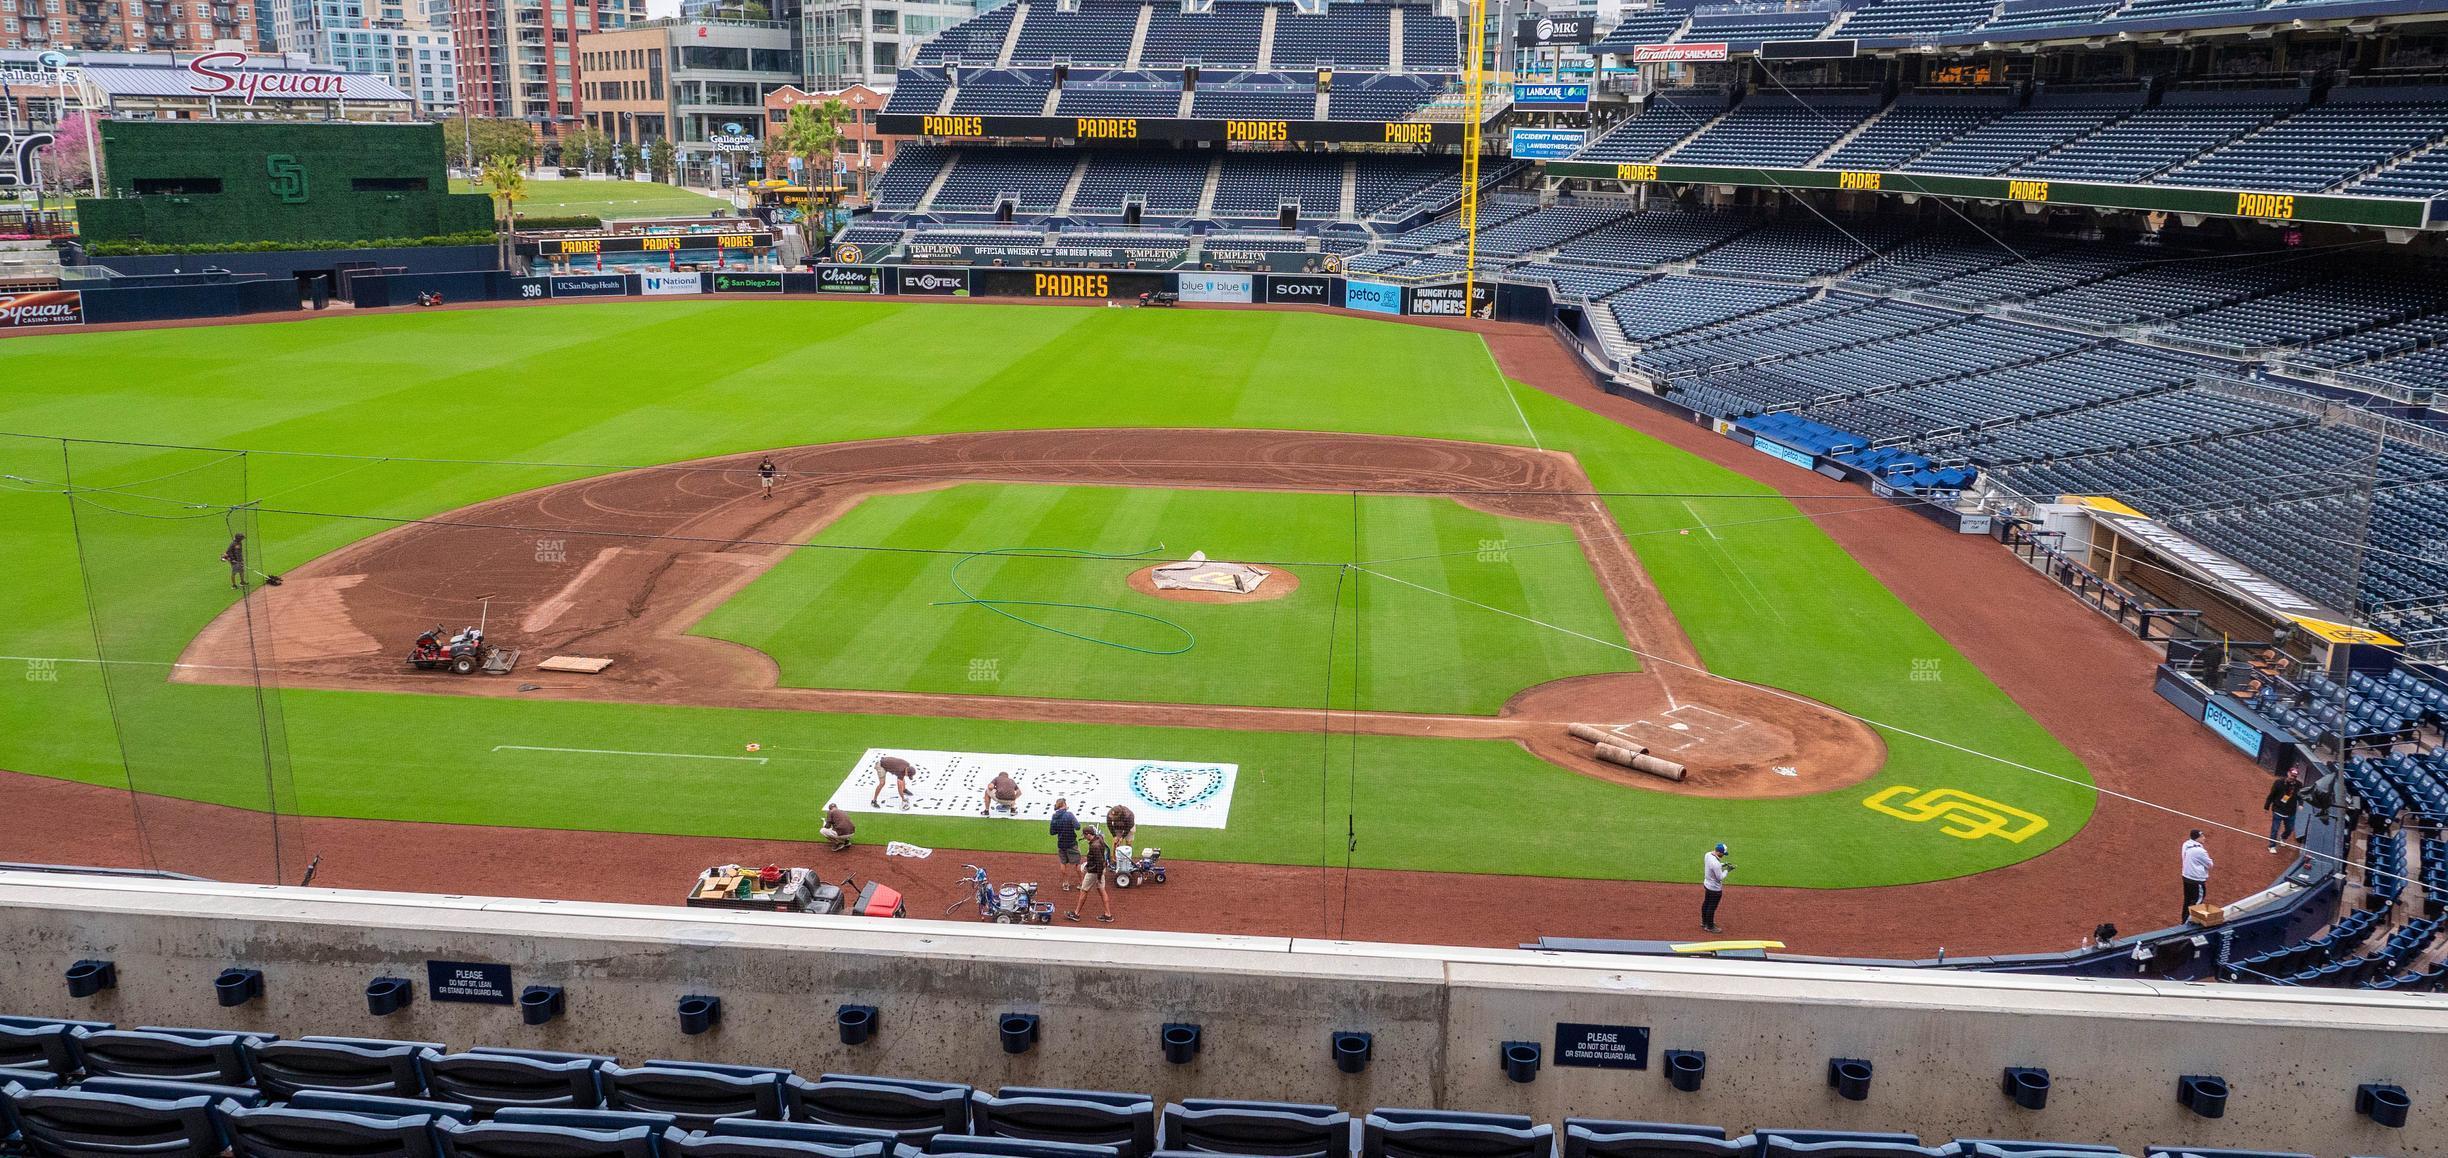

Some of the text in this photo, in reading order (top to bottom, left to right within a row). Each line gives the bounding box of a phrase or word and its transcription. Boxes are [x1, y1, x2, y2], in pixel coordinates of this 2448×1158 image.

[1553, 22, 1579, 33] MRC
[1637, 47, 1725, 60] Tarantino SAUSAGES
[189, 51, 348, 105] Sycuan
[1526, 87, 1587, 97] LANDCARE LOGIC
[923, 116, 983, 136] PADRES
[1078, 119, 1137, 138] PADRES
[1227, 121, 1288, 141] PADRES
[1385, 123, 1432, 143] PADRES
[711, 135, 755, 144] Gallagher
[718, 143, 749, 152] Square
[1617, 164, 1657, 181] PADRES
[1840, 172, 1881, 190] PADRES
[2009, 180, 2048, 201] PADRES
[2237, 193, 2294, 219] PADRES
[561, 240, 600, 253] PADRES
[643, 238, 681, 250] PADRES
[718, 236, 754, 248] PADRES
[910, 245, 961, 254] TEMPLETON
[974, 247, 1006, 255] OFFICIAL
[1007, 248, 1039, 256] WHISKEY
[1088, 249, 1113, 257] PADRES
[1125, 249, 1179, 259] TEMPLETON
[1212, 251, 1266, 261] TEMPLETON
[822, 267, 867, 281] Chosen
[558, 281, 620, 291] UC San Diego Health
[663, 277, 697, 285] National
[745, 280, 766, 288] Diego
[905, 274, 962, 290] EVOTEK
[1035, 273, 1109, 297] PADRES
[1181, 280, 1204, 290] blue
[1216, 282, 1239, 291] blue
[522, 285, 542, 298] 396
[1276, 284, 1324, 296] SONY
[1350, 288, 1381, 303] petco
[1417, 288, 1463, 298] HUNGRY FOR
[1472, 287, 1485, 300] 322
[0, 296, 73, 326] Sycuan
[1413, 299, 1466, 315] HOMERS
[2207, 706, 2233, 731] petco
[1863, 785, 2048, 843] SD
[456, 970, 483, 979] PLEASE
[474, 988, 491, 996] GUARD
[492, 989, 503, 997] RAIL
[1587, 1032, 1618, 1042] PLEASE
[1578, 1042, 1586, 1050] DO
[1574, 1050, 1593, 1058] STAND
[1594, 1051, 1602, 1059] ON
[1603, 1052, 1623, 1060] GUARD
[1624, 1053, 1637, 1061] RAIL
